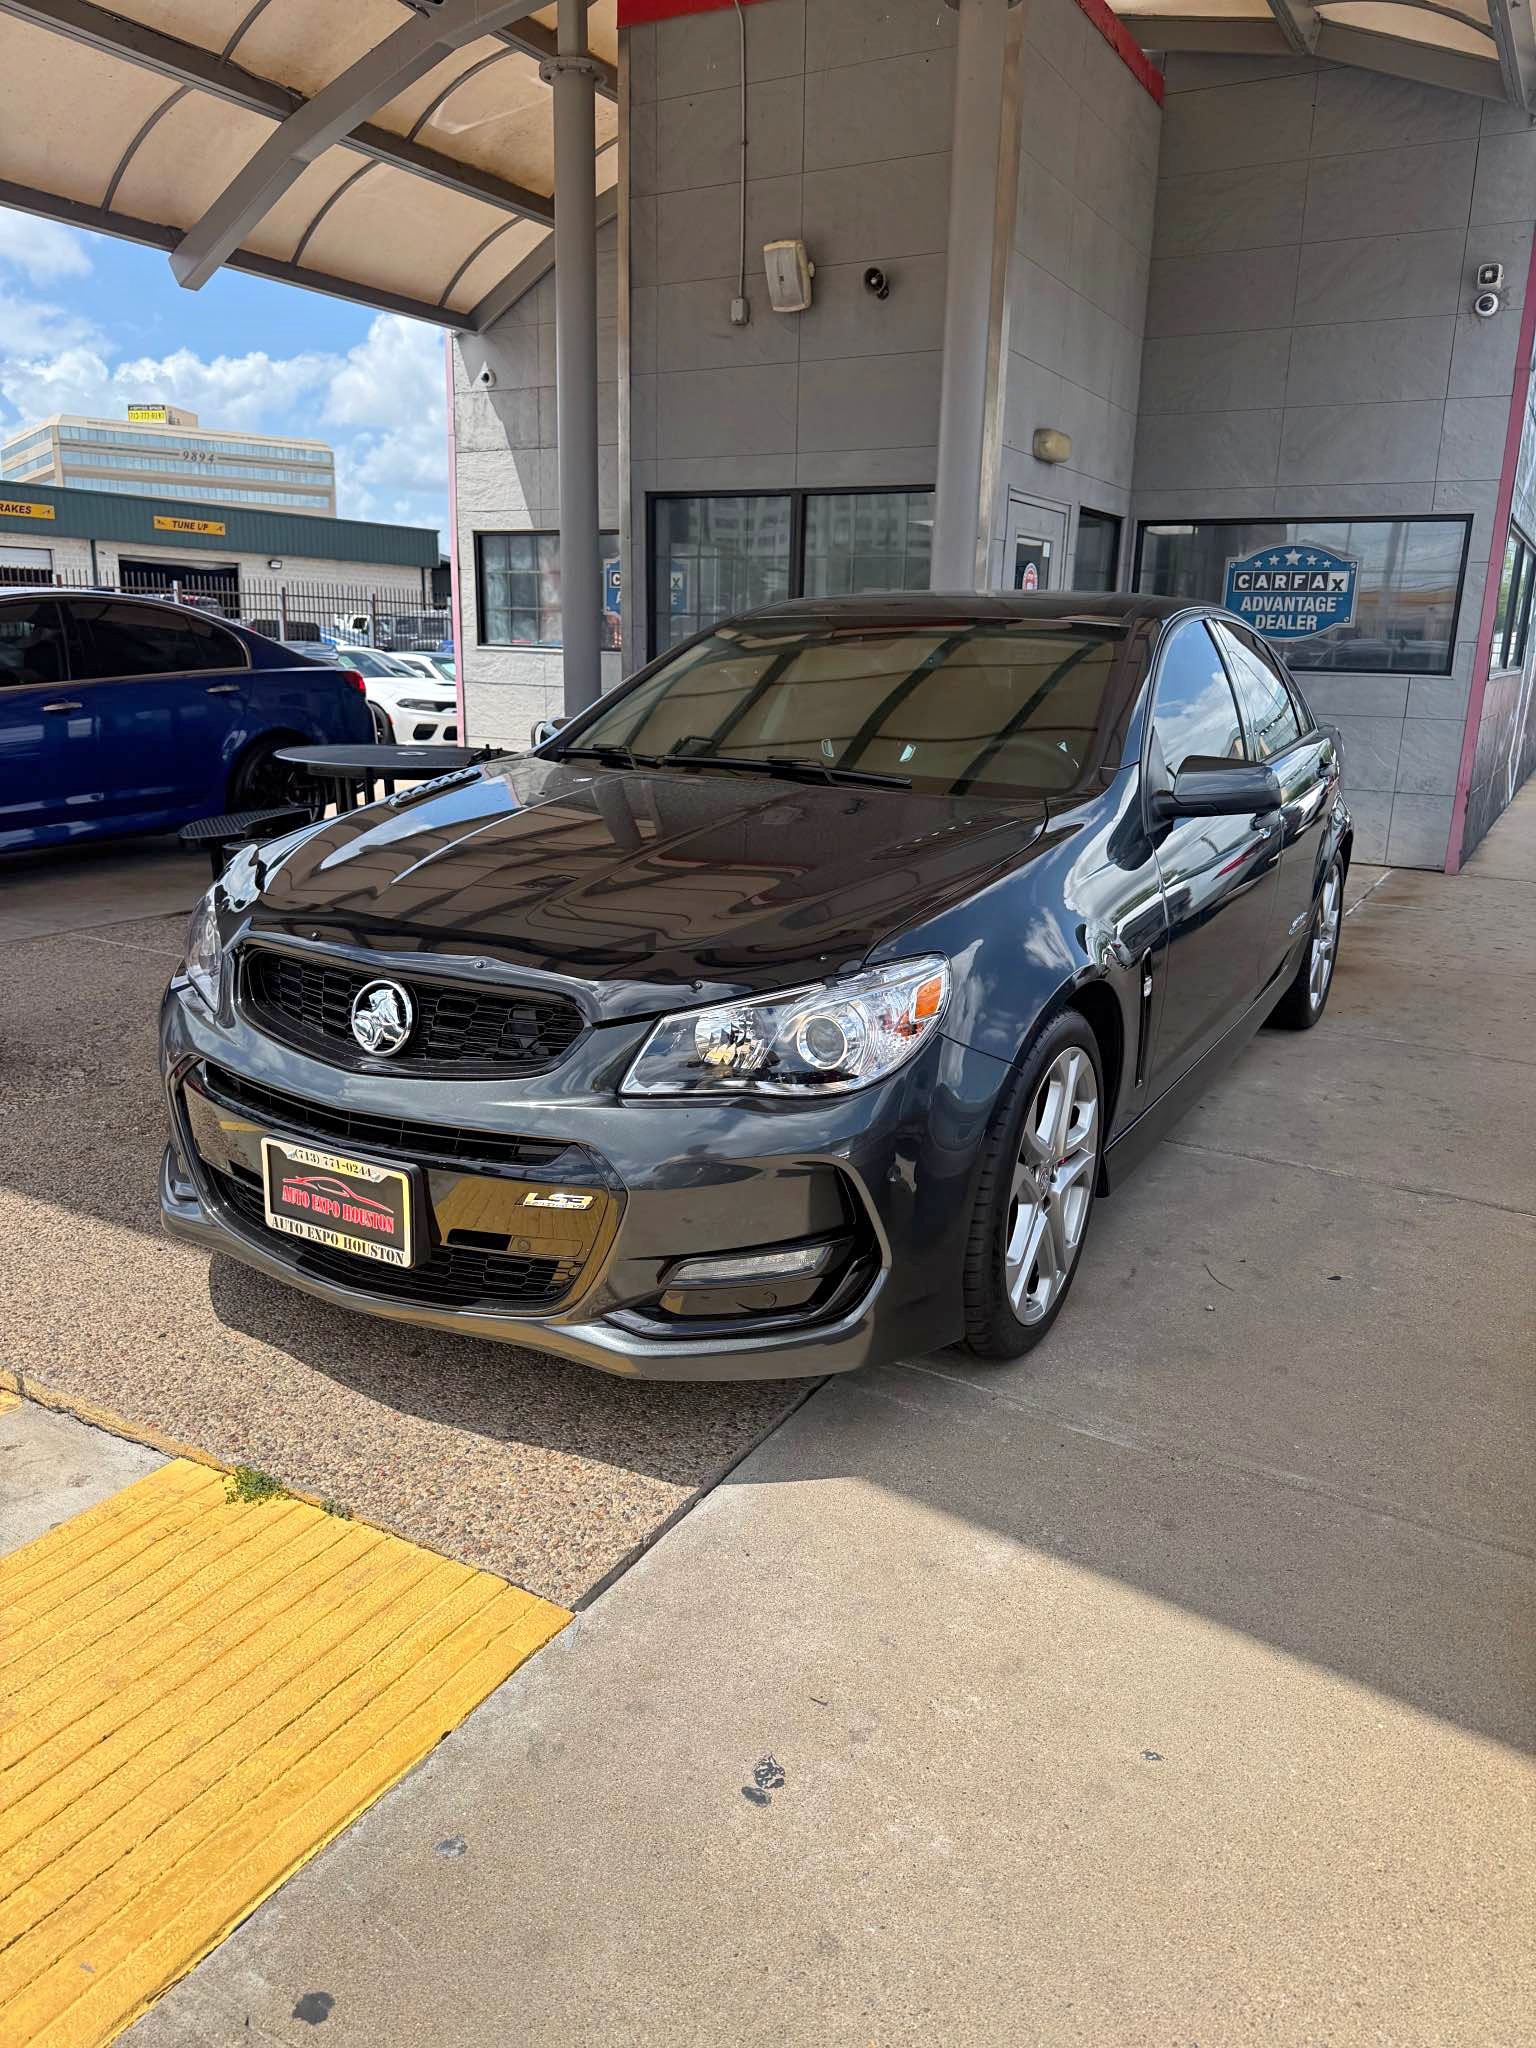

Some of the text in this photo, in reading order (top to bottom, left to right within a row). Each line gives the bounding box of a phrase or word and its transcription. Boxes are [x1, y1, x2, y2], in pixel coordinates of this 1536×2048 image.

[183, 450, 216, 464] 9894
[172, 520, 209, 531] TUNE UP
[1237, 573, 1345, 592] CARFAX
[1240, 596, 1337, 613] ADVANTAGE
[1254, 614, 1318, 631] DEALER
[293, 1149, 320, 1165] (713)
[523, 1192, 594, 1209] LS3
[281, 1184, 395, 1235] AUTO EXPO HOUSTON
[271, 1215, 405, 1266] AUTO EXPO HOUSTON
